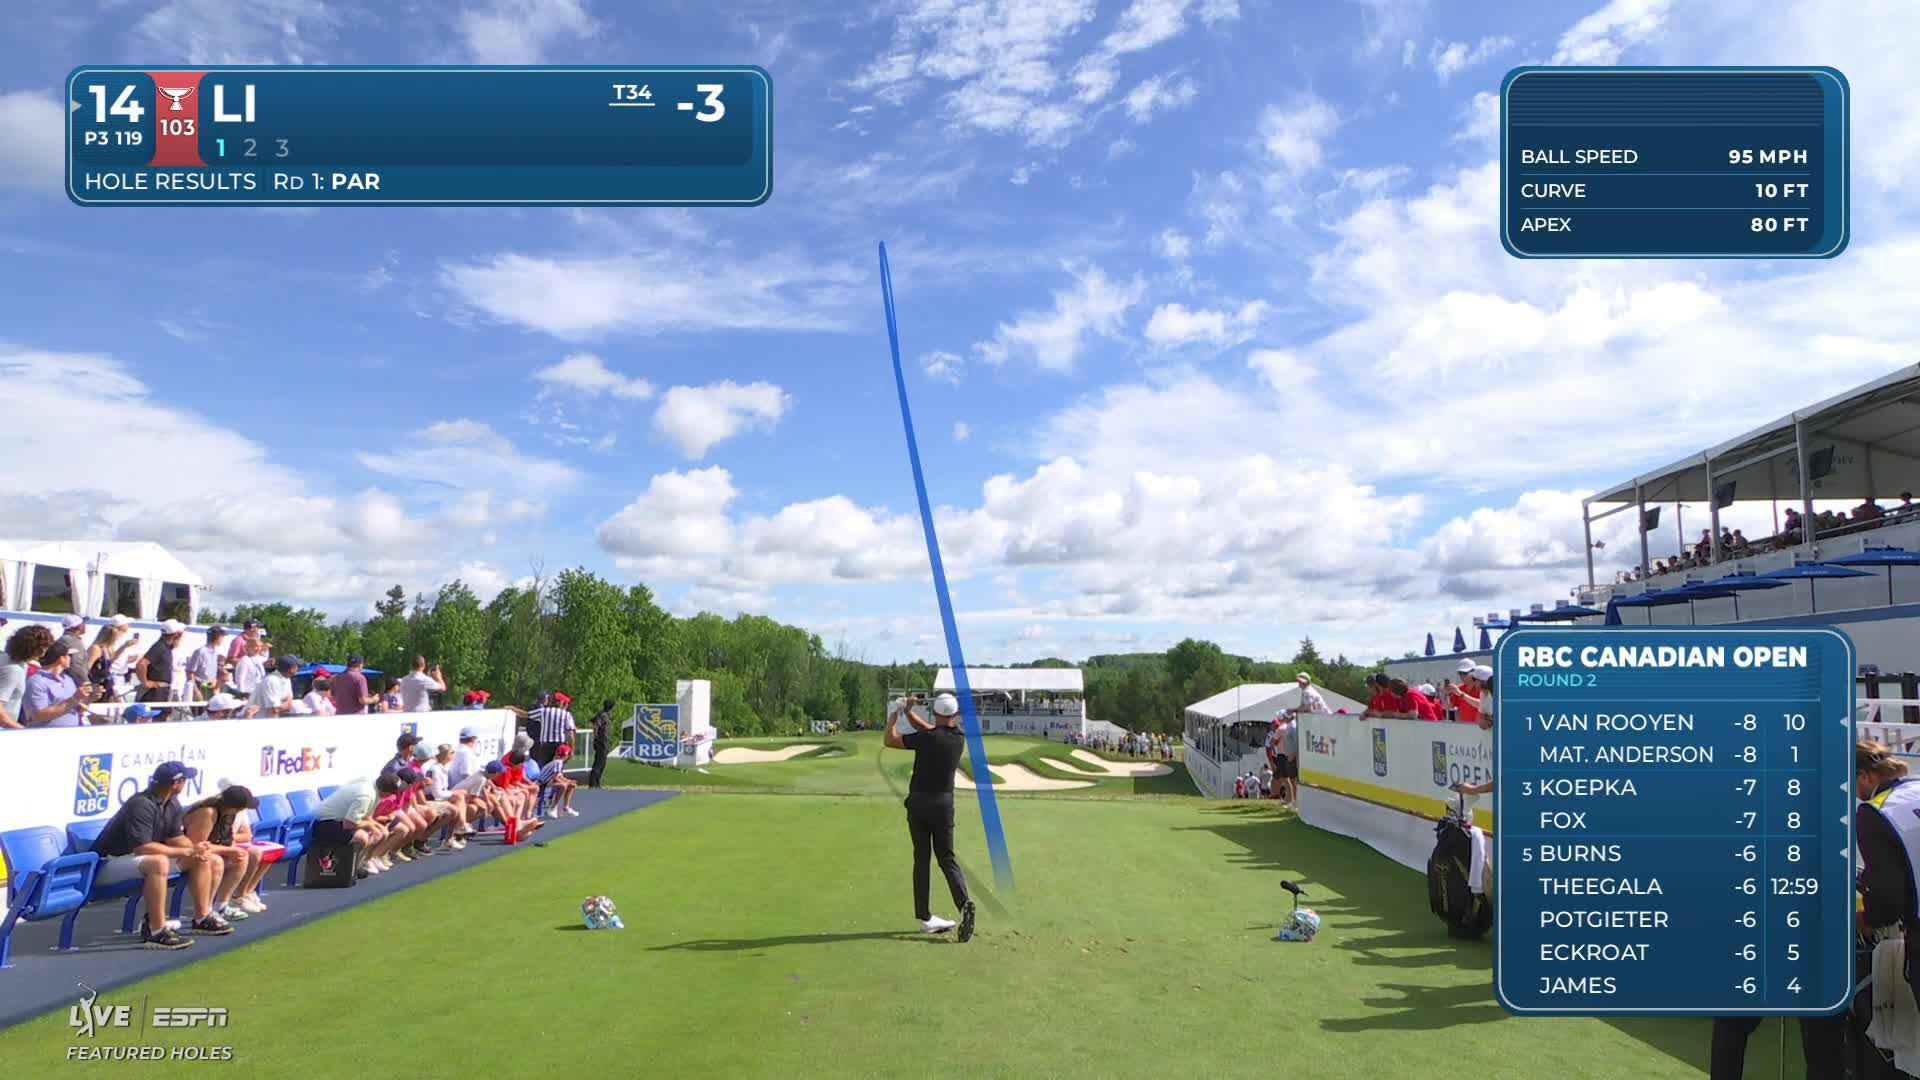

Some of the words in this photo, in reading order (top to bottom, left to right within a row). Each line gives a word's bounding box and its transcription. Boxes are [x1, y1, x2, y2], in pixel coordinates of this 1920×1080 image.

[120, 744, 206, 768] CANADIAN
[276, 747, 320, 775] FedEx
[639, 743, 675, 757] RBC
[118, 769, 203, 806] ON
[76, 797, 107, 813] RBC
